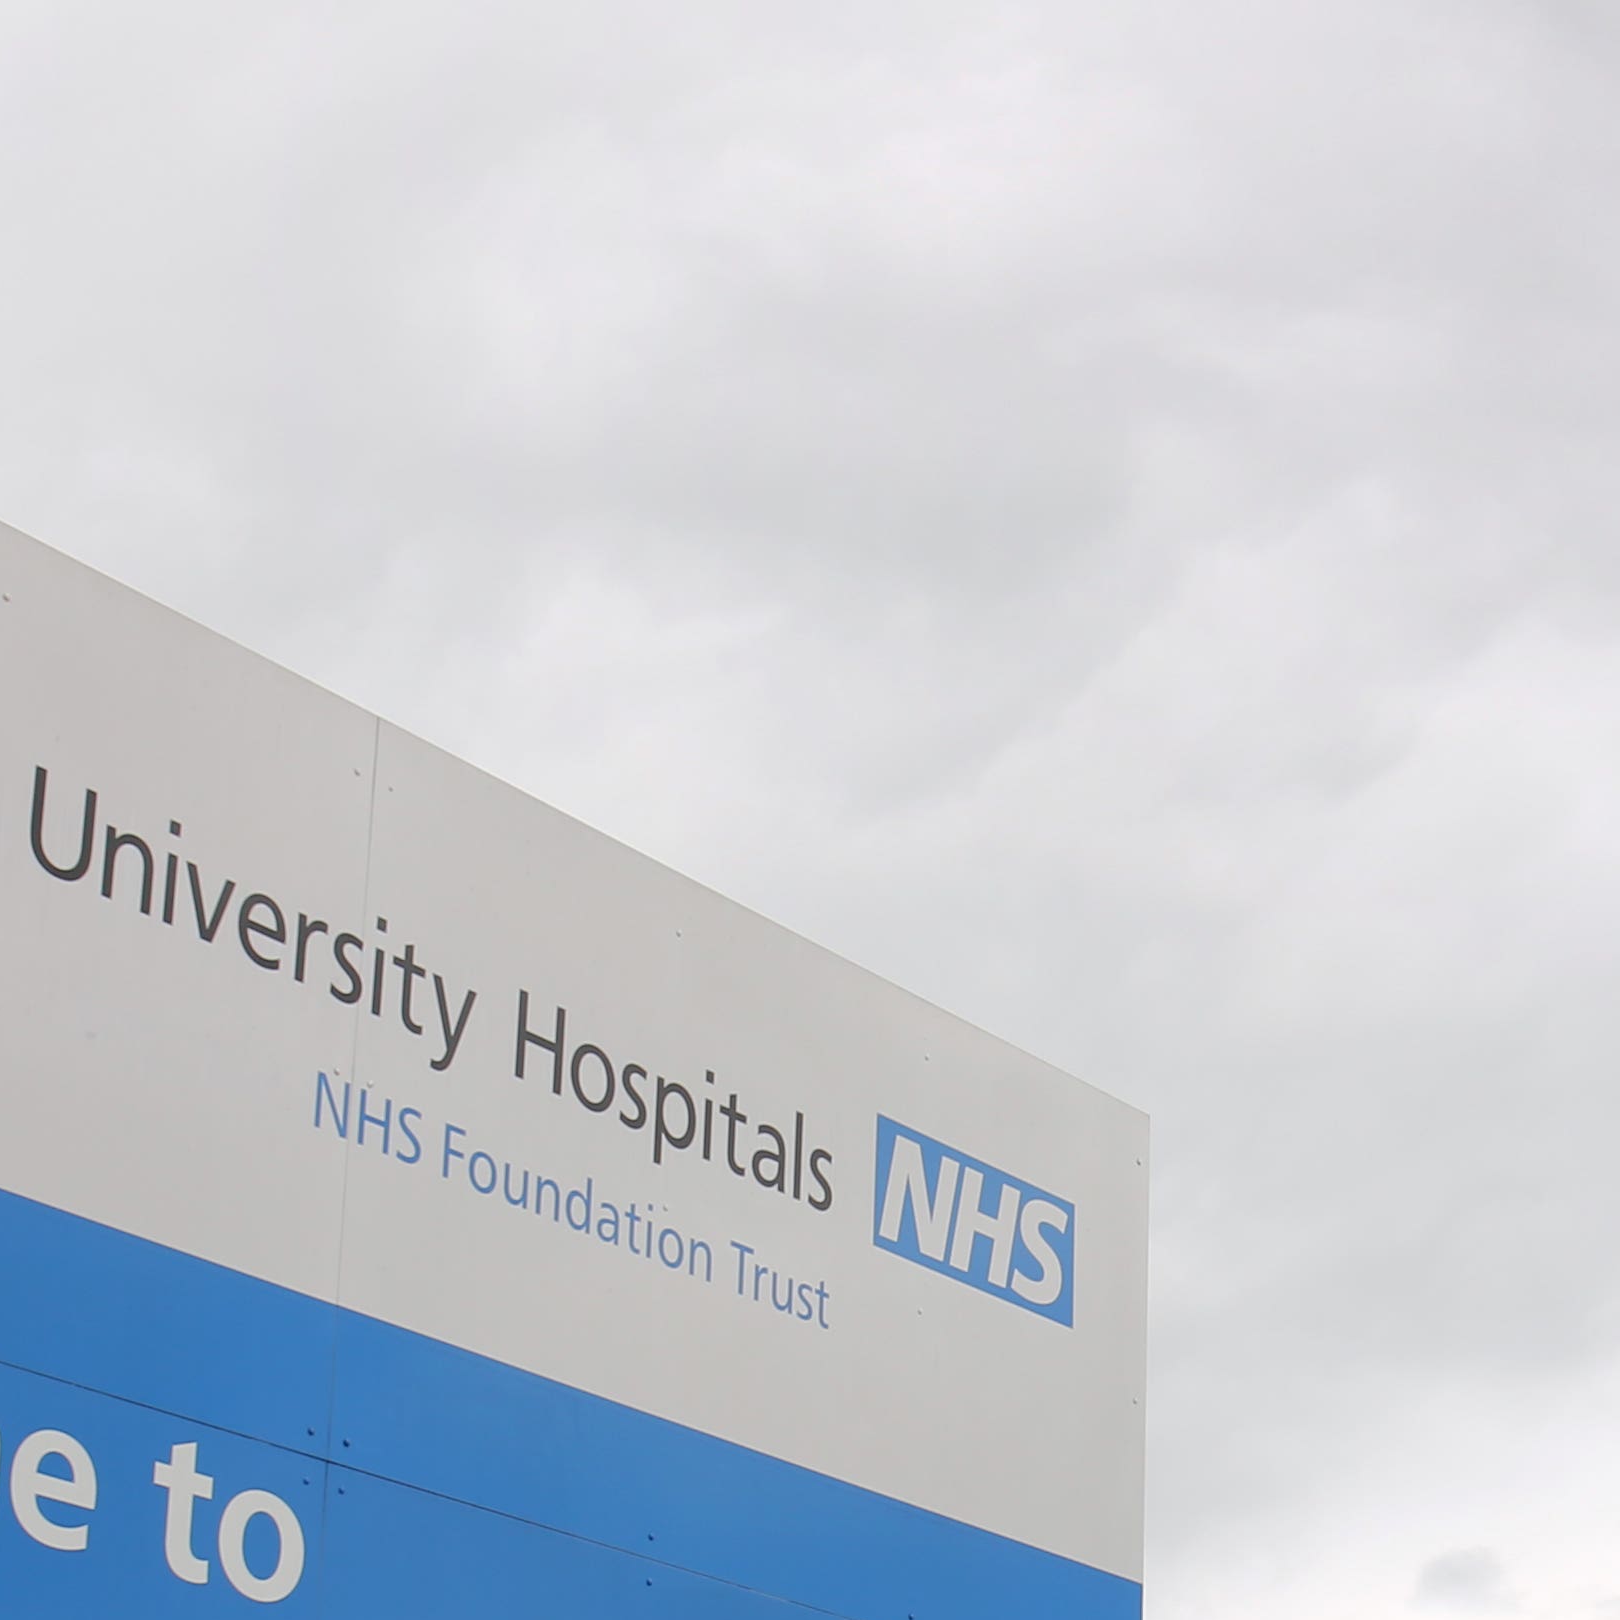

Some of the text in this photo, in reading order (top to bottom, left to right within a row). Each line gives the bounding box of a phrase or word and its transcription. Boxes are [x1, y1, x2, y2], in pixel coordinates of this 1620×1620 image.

[31, 766, 477, 1072] University
[515, 990, 832, 1212] Hospitals
[313, 1072, 830, 1330] NHS Foundation Trust
[877, 1133, 1070, 1307] NHS
[152, 1442, 305, 1603] to
